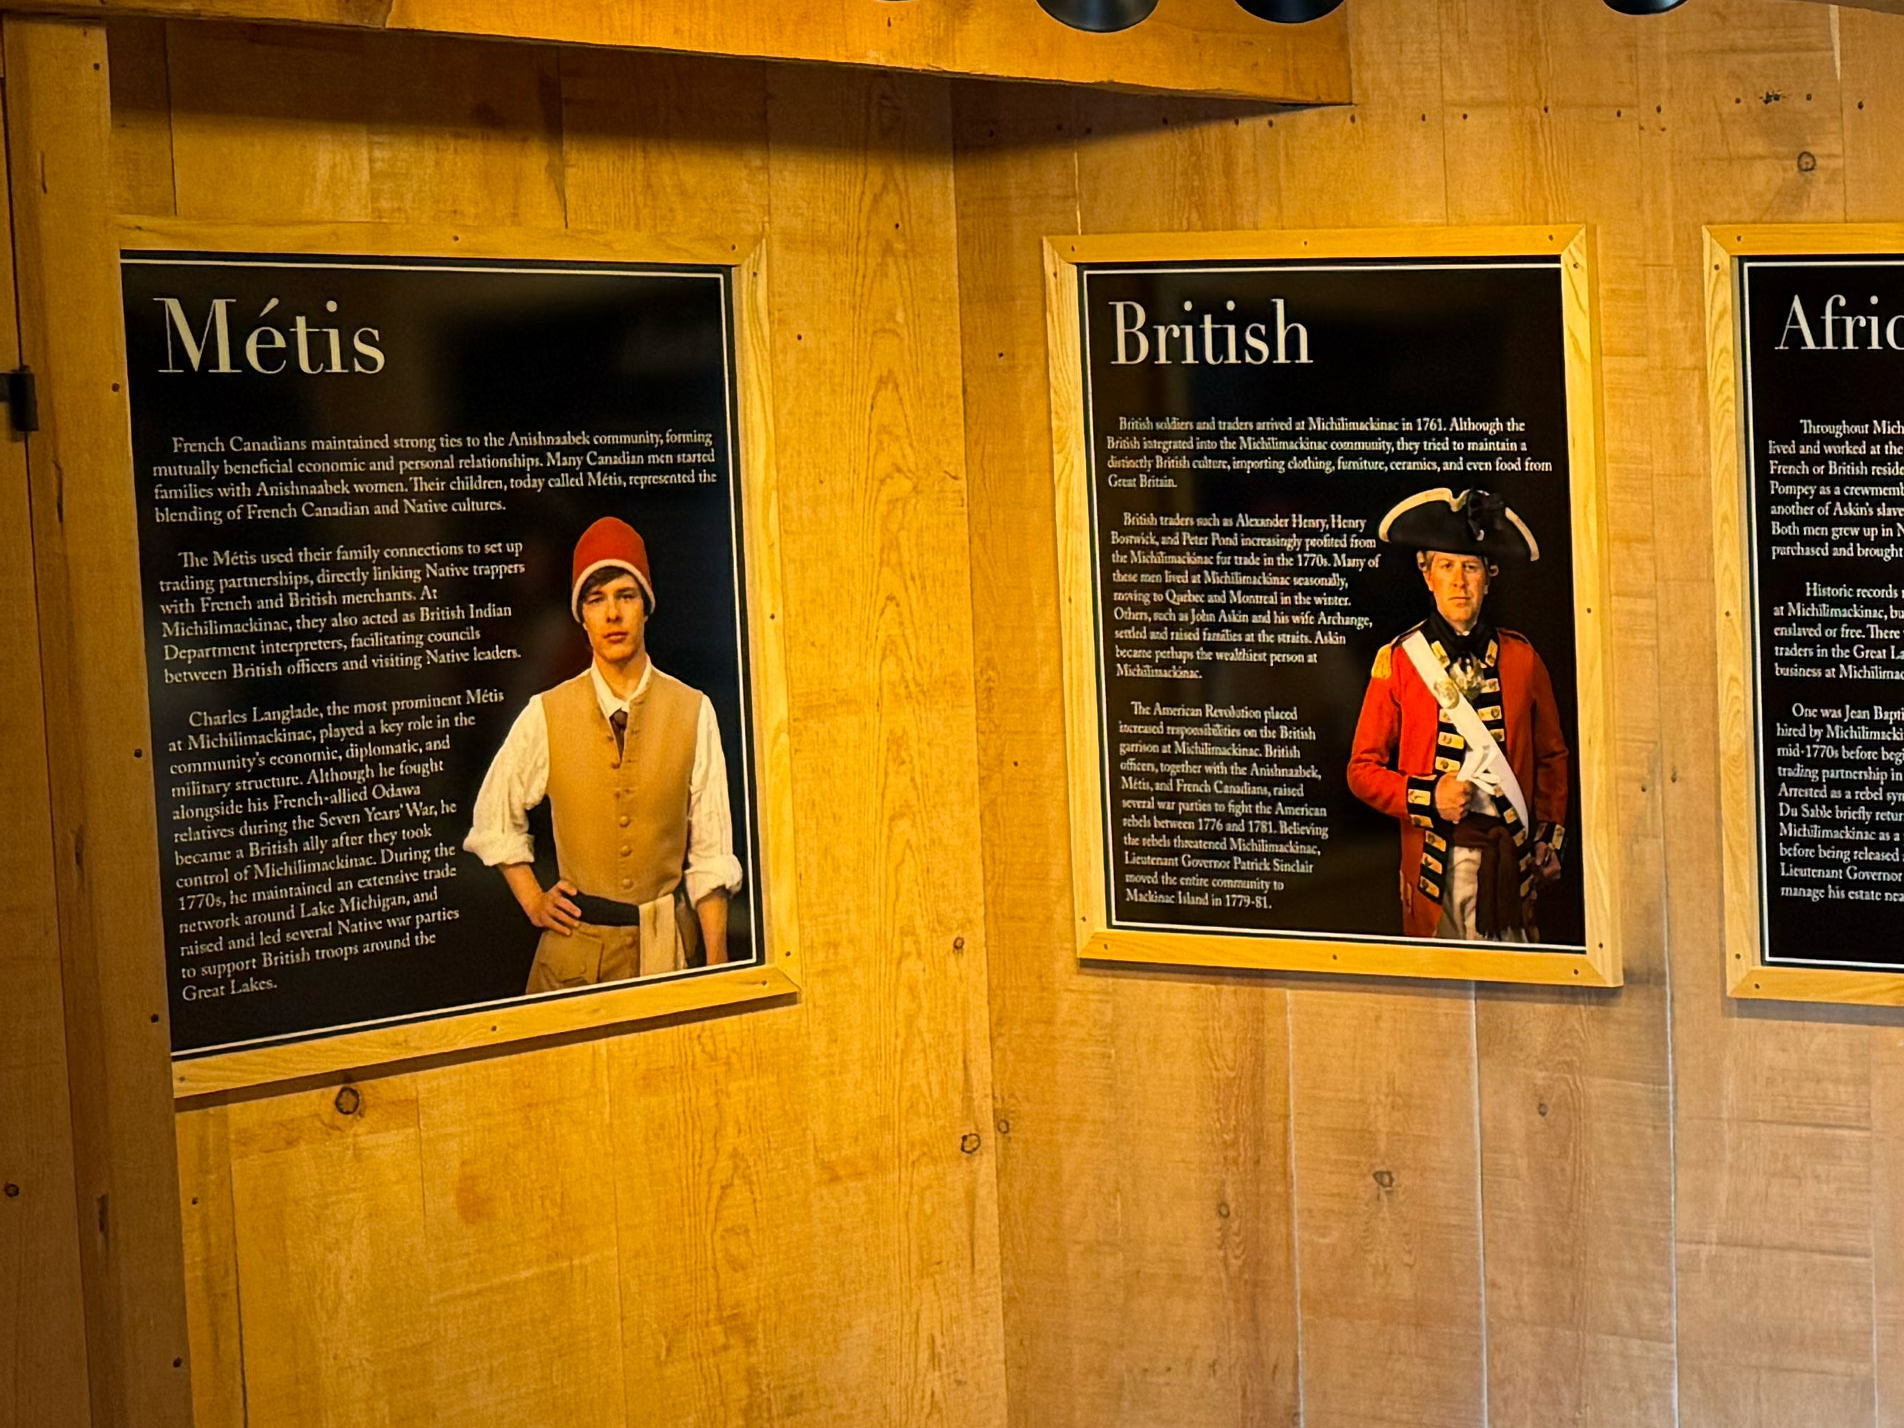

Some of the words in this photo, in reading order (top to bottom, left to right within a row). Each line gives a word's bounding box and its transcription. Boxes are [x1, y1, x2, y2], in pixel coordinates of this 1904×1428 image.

[153, 297, 385, 375] Métis
[1108, 297, 1314, 365] British
[1118, 416, 1154, 431] British
[1156, 417, 1194, 431] soldiers
[1196, 417, 1216, 431] and
[1217, 416, 1254, 431] traders
[1255, 416, 1293, 431] arrived
[1294, 420, 1306, 431] at
[1307, 416, 1400, 431] Michilimackinac
[1401, 417, 1414, 432] in
[1416, 417, 1447, 432] 1761.
[1448, 416, 1504, 436] Although
[1506, 417, 1526, 432] the
[1799, 419, 1870, 439] Throughout
[172, 436, 226, 453] French
[229, 435, 307, 452] Canadians
[311, 433, 390, 451] maintained
[393, 437, 437, 453] strong
[439, 433, 463, 448] ties
[466, 436, 481, 448] to
[483, 431, 505, 447] the
[507, 430, 591, 447] Anishnaabek
[592, 430, 664, 448] community,
[665, 428, 713, 447] forming
[154, 505, 223, 525] blending
[226, 504, 245, 520] of
[246, 502, 298, 520] French
[301, 500, 370, 518] Canadian
[373, 498, 400, 515] and
[402, 498, 448, 514] Native
[451, 496, 507, 513] cultures.
[177, 551, 209, 568] The
[212, 549, 257, 567] Métis
[260, 547, 294, 565] used
[297, 546, 333, 563] their
[336, 543, 381, 564] family
[383, 541, 464, 559] connections
[467, 543, 481, 555] to
[484, 542, 503, 554] set
[505, 542, 524, 558] up
[1791, 702, 1818, 718] One
[1819, 708, 1843, 719] was
[1843, 704, 1871, 723] Jean
[1124, 850, 1179, 867] Lieutenant
[1181, 853, 1231, 870] Governor
[1232, 855, 1271, 872] Patrick
[1272, 857, 1314, 874] Sinclair
[1124, 871, 1159, 885] moved
[1160, 871, 1178, 886] the
[1179, 873, 1209, 888] entire
[1211, 877, 1271, 894] community
[1272, 880, 1285, 891] to
[1125, 887, 1176, 904] Mackinac
[1177, 890, 1210, 906] Island
[1211, 893, 1223, 907] in
[1225, 893, 1273, 909] 1779-81.
